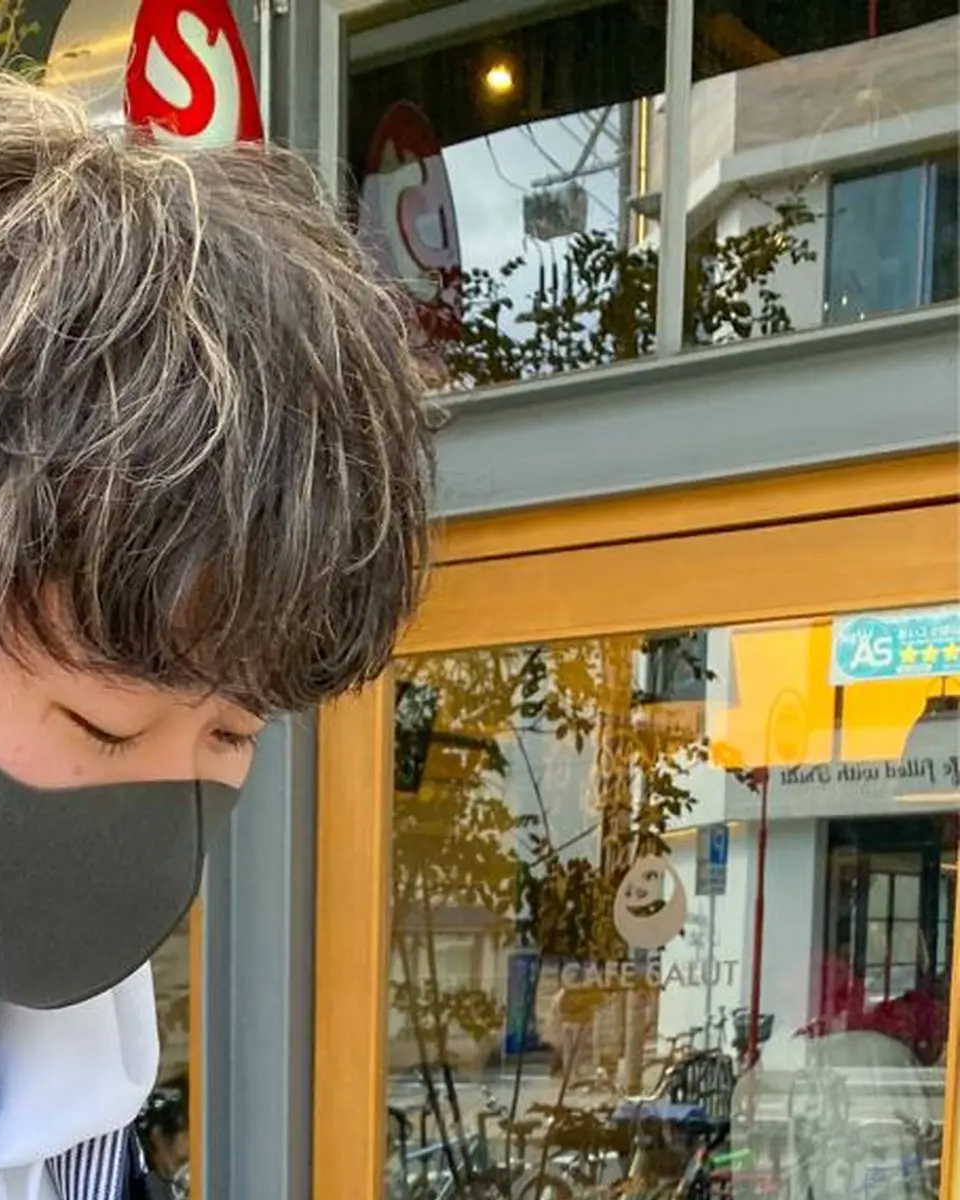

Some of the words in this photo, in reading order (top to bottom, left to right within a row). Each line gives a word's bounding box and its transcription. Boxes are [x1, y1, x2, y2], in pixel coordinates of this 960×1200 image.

[849, 633, 893, 670] AS
[561, 961, 637, 988] CAFE
[645, 960, 739, 988] SALUT
